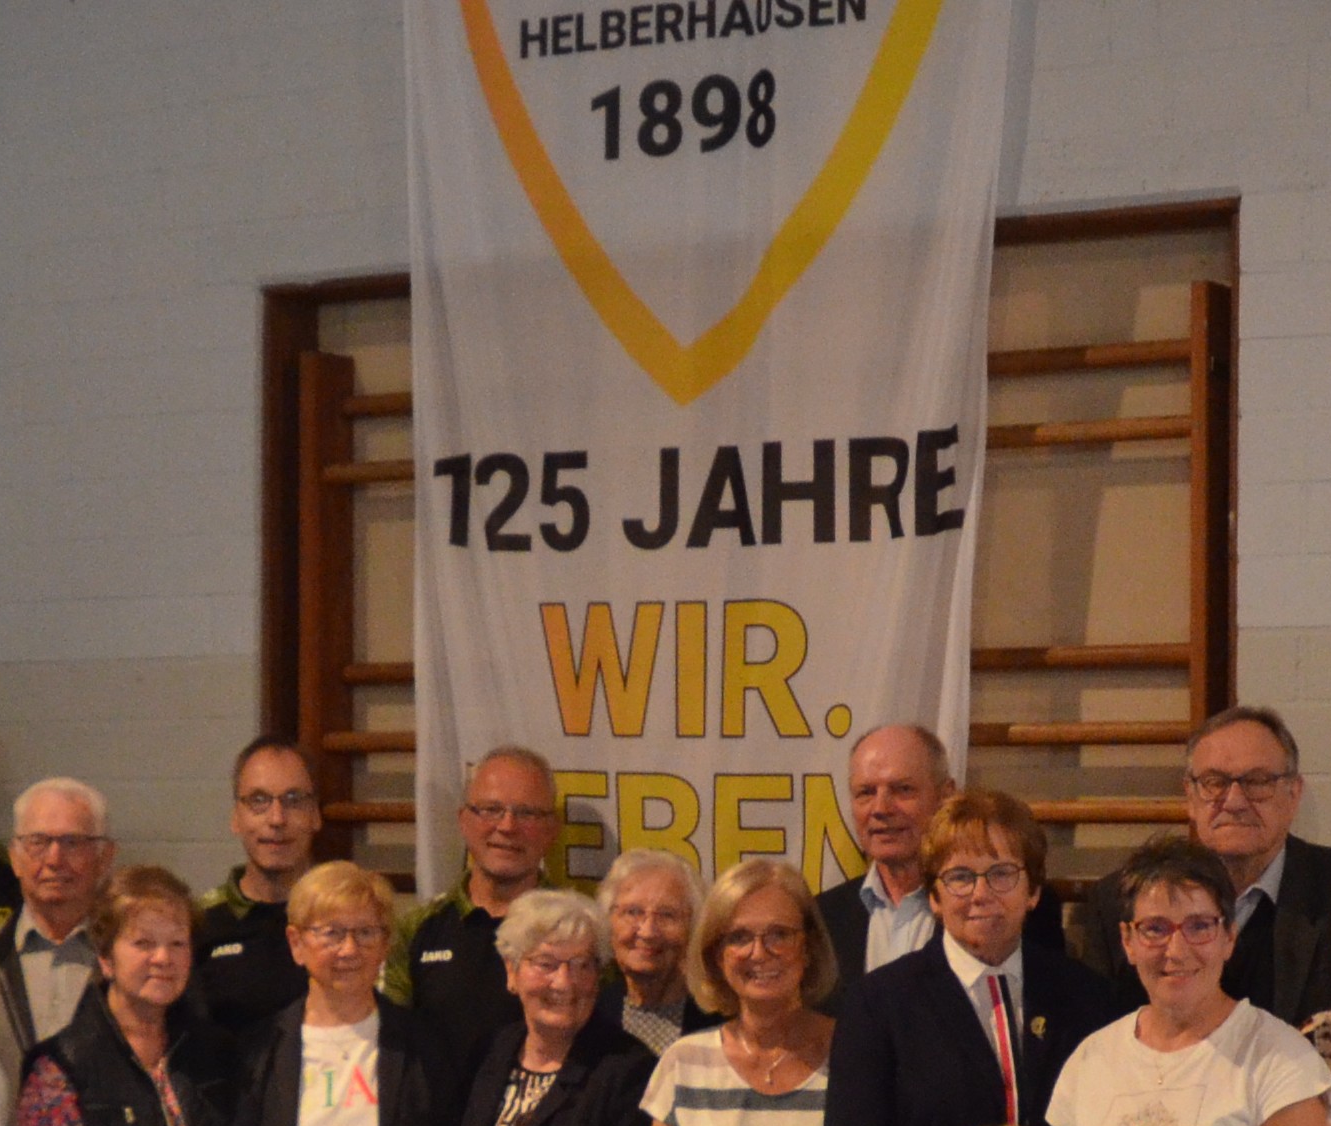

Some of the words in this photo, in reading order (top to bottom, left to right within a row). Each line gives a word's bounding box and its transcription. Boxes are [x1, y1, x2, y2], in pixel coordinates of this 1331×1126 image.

[519, 0, 868, 59] HELBERHAUSEN
[590, 68, 777, 161] 1898
[433, 450, 590, 552] 125
[621, 423, 966, 550] JAHRE
[538, 599, 853, 738] WIR.
[468, 764, 871, 900] EBEN
